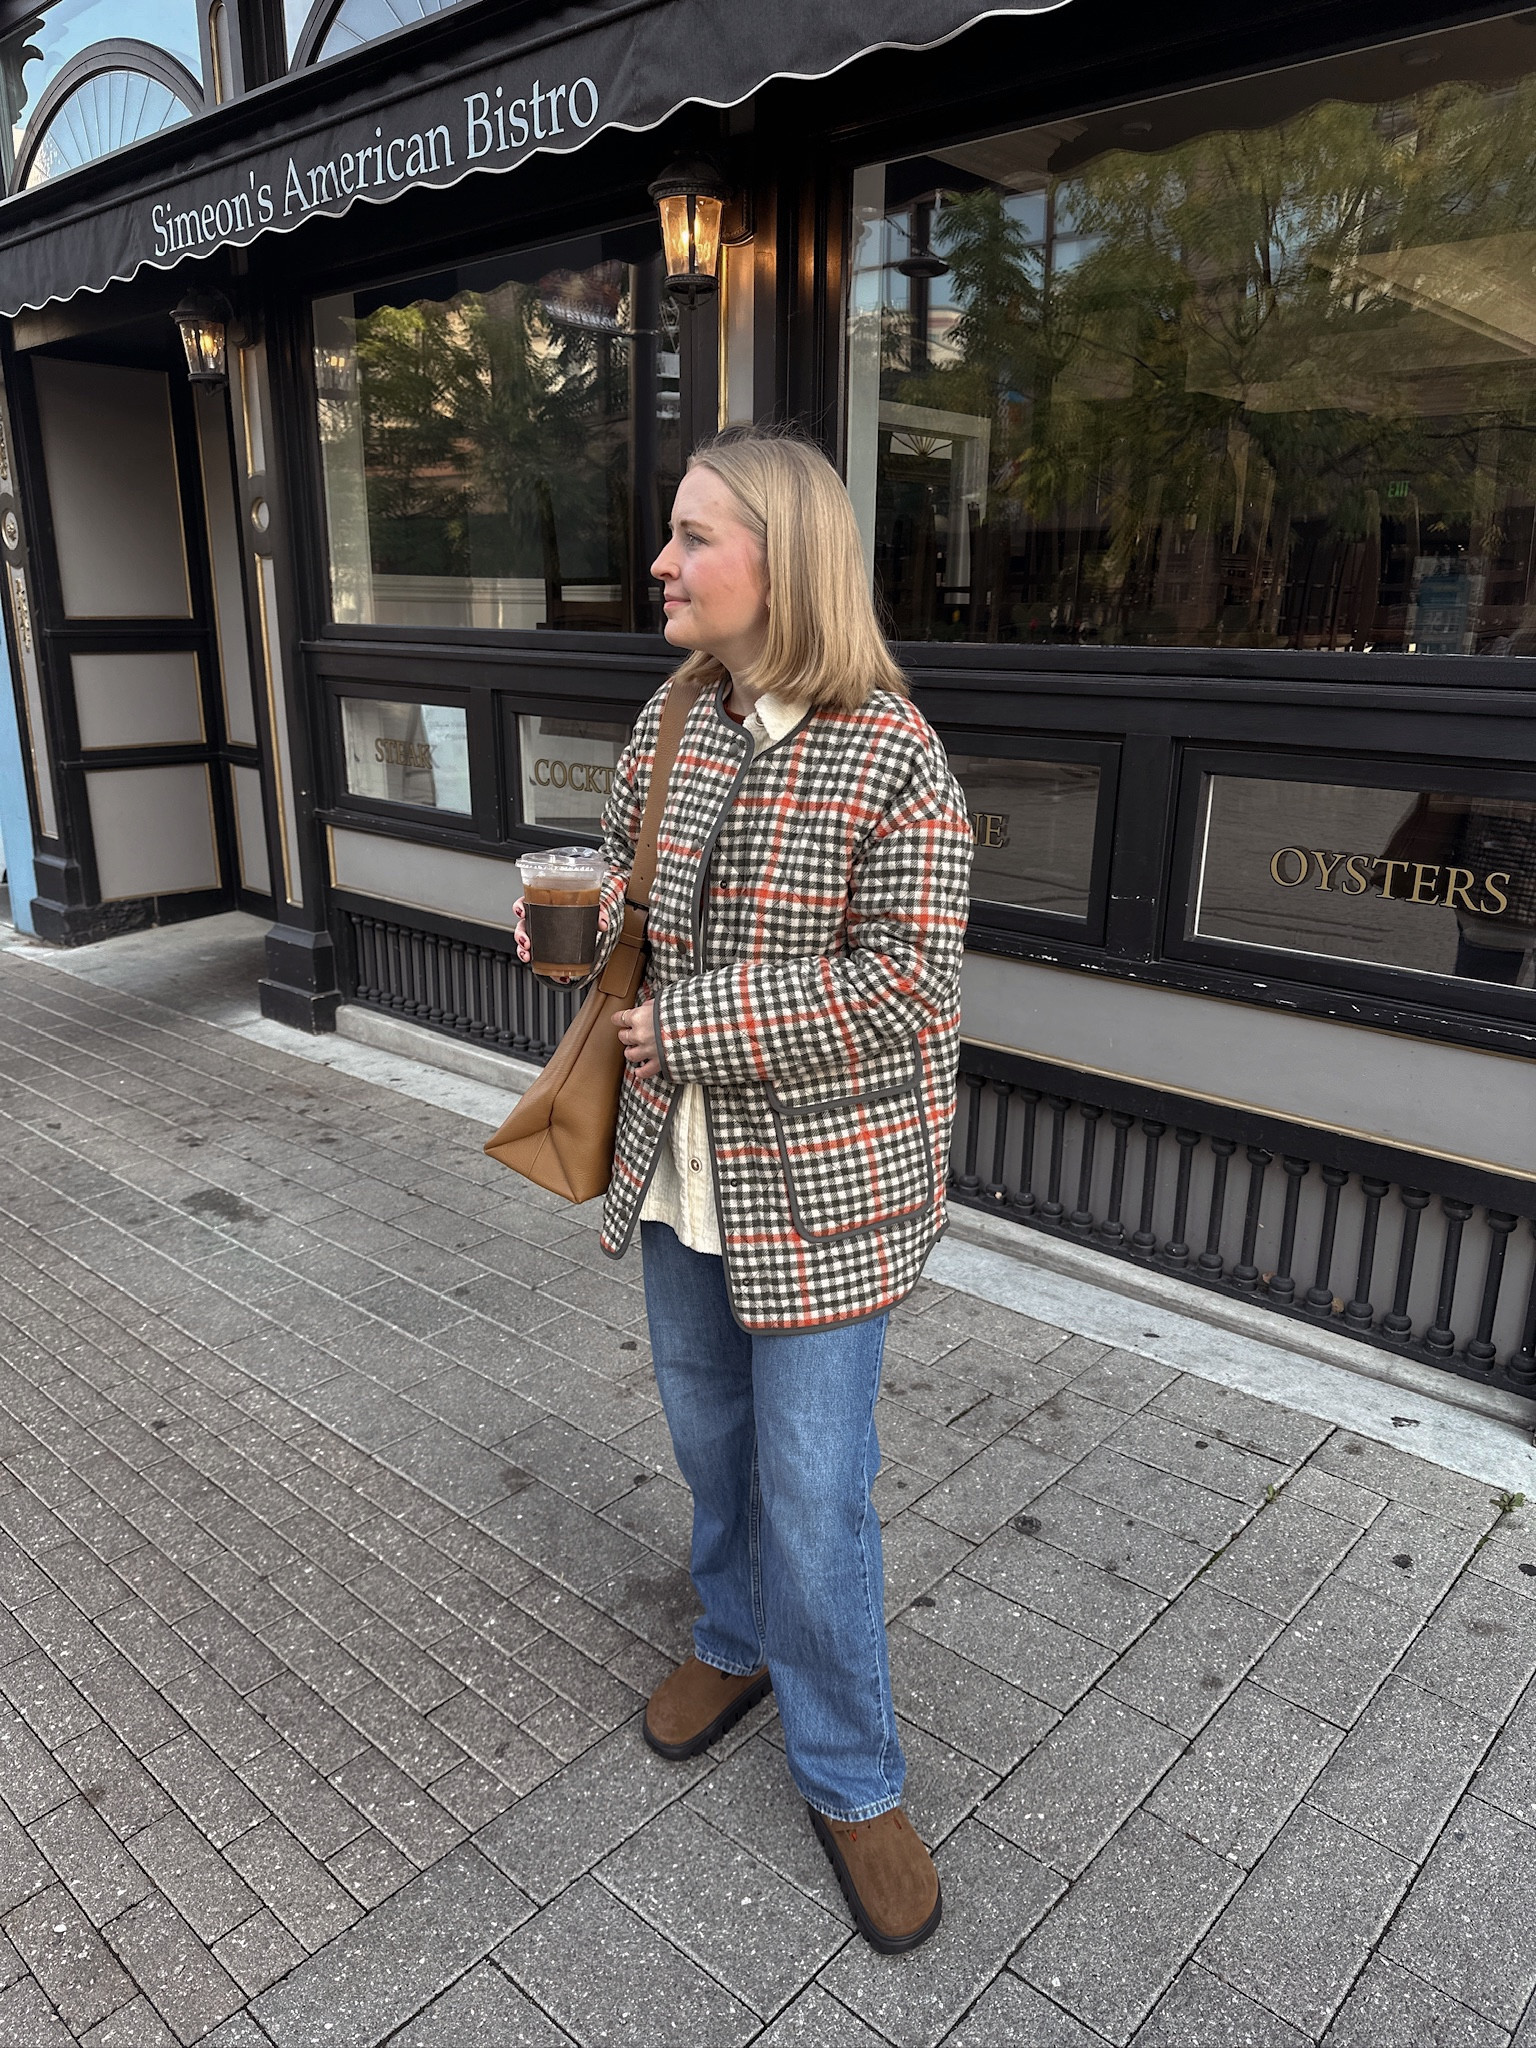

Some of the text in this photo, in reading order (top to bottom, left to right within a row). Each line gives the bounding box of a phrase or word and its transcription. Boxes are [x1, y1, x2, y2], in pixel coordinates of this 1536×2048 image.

[152, 76, 600, 257] Simeon's American Bistro
[1387, 480, 1410, 498] EXIT
[374, 737, 433, 770] STEAK
[1270, 847, 1511, 915] OYSTERS
